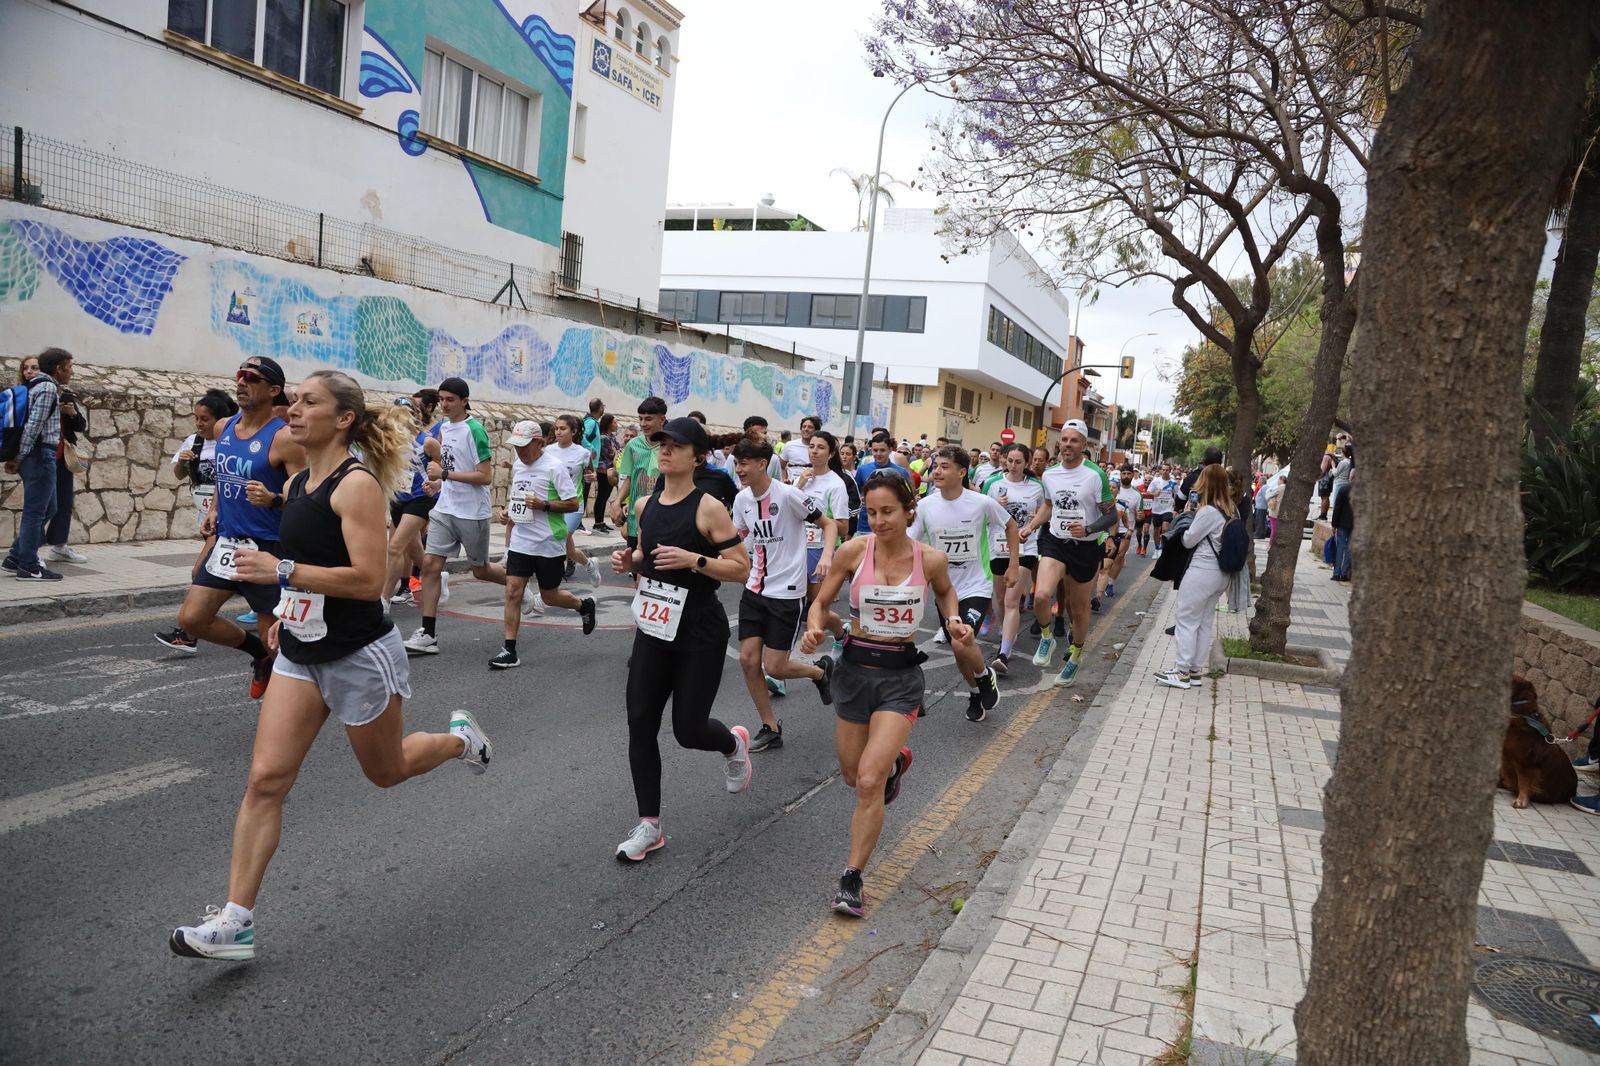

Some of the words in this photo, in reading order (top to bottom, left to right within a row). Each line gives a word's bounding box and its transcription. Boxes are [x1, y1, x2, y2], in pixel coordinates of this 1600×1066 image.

[612, 68, 633, 92] SAFA
[642, 88, 660, 106] ICET
[216, 452, 253, 479] RCM
[512, 503, 526, 514] 497
[944, 541, 970, 553] 771
[280, 597, 312, 622] 117
[640, 600, 670, 624] 124
[873, 607, 914, 624] 334
